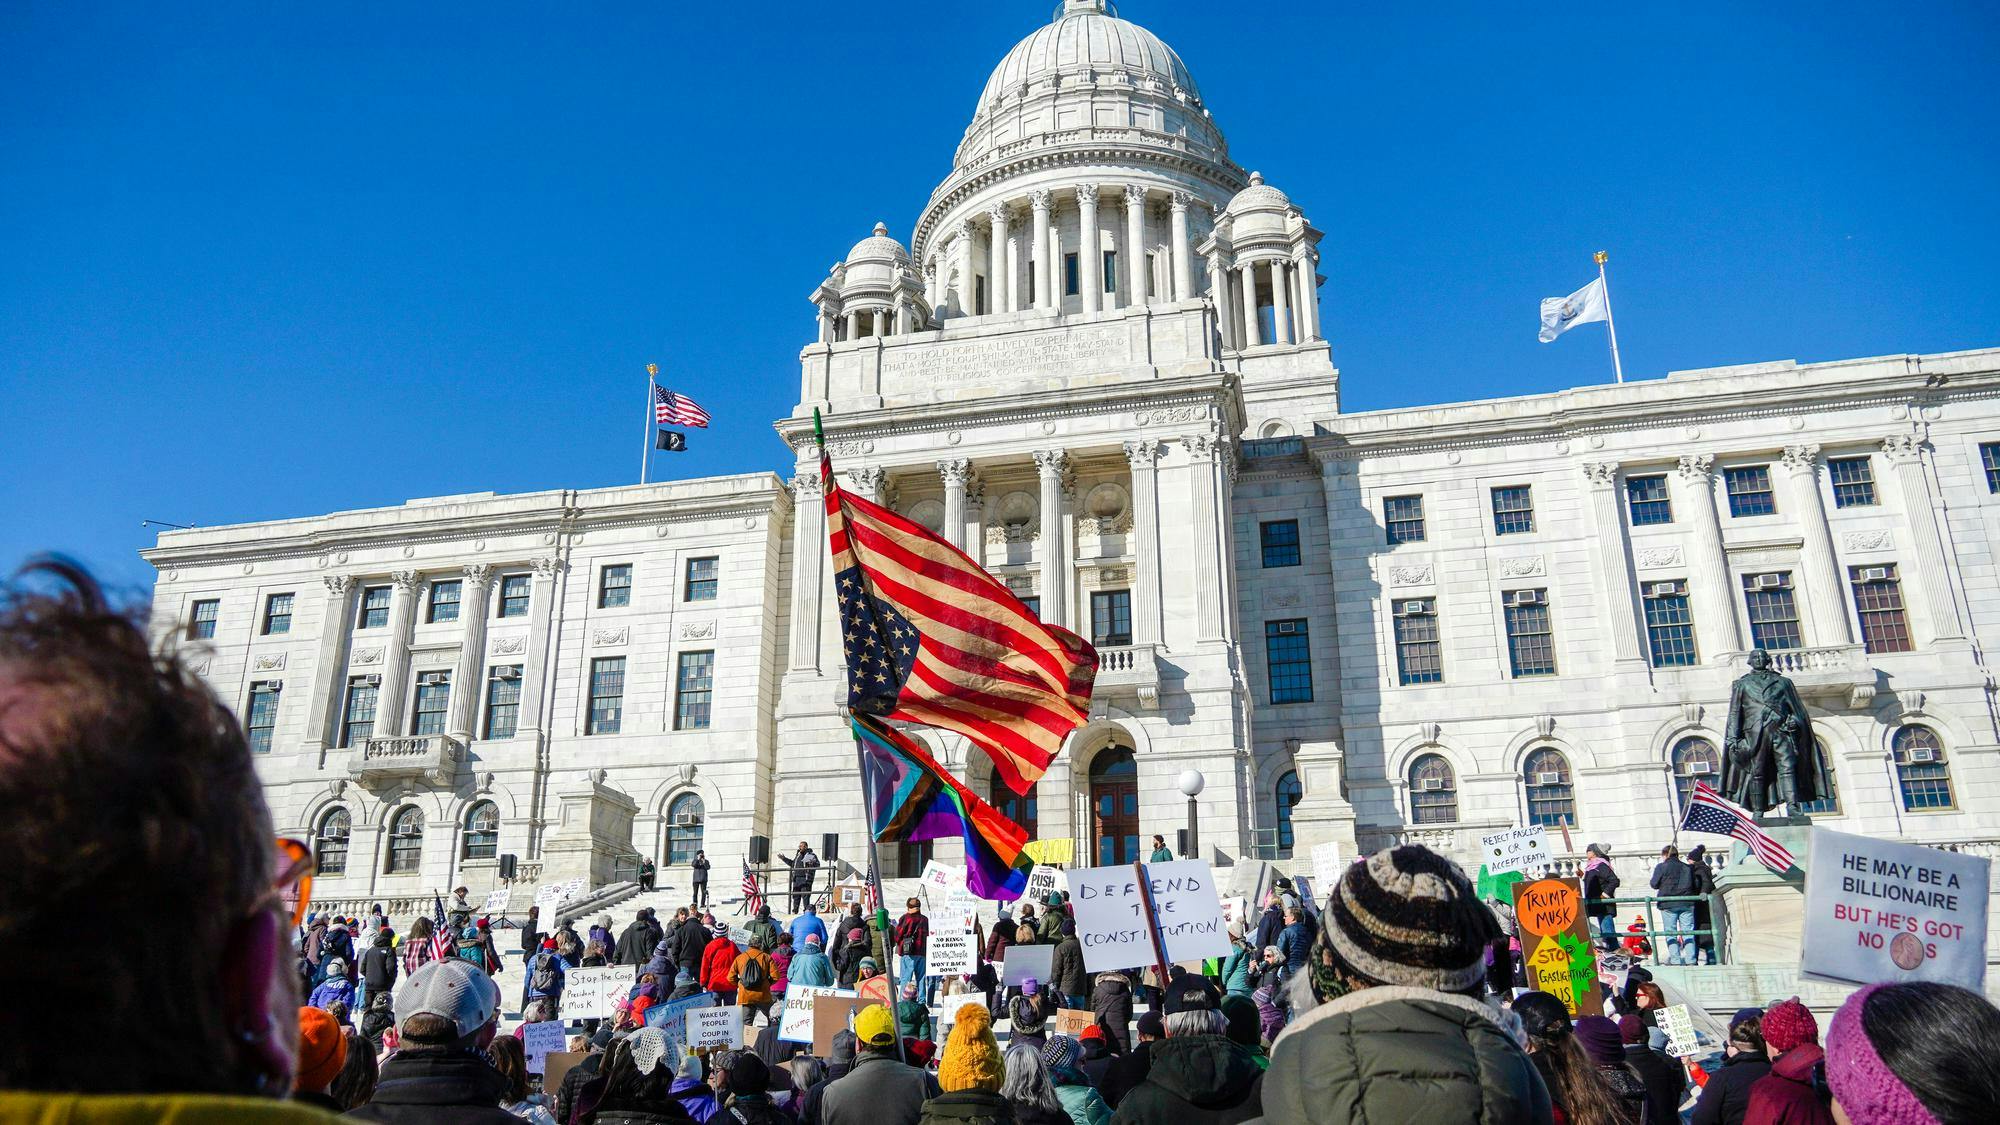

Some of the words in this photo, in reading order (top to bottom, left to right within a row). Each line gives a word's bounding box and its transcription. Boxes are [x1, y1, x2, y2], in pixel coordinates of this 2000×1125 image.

[883, 361, 908, 372] THAT
[1013, 347, 1039, 358] CIVIL
[1042, 344, 1069, 355] STATE
[1073, 341, 1092, 351] MAY
[921, 348, 949, 359] HOLD
[952, 343, 984, 355] FORTH
[996, 340, 1030, 351] LIVELY
[920, 366, 941, 376] BEST
[1482, 833, 1509, 846] REJECT
[1513, 826, 1544, 840] FASCISM
[1508, 842, 1522, 854] OR
[1491, 856, 1520, 872] ACCEPT
[1522, 852, 1546, 865] DEATH
[1842, 853, 1867, 872] HE
[1872, 859, 1912, 880] MAY
[1917, 868, 1942, 885] BE
[1947, 873, 1961, 889] A
[1031, 873, 1055, 889] PUSH
[1080, 876, 1201, 900] DEFEND
[1523, 889, 1568, 912] TRUMP
[1842, 876, 1958, 911] BILLIONAIRE
[1536, 907, 1571, 929] MUSK
[1834, 903, 1872, 924] BUT
[1876, 911, 1919, 933] HE'S
[1924, 920, 1964, 940] GOT
[1083, 917, 1218, 947] CONSTITUTION
[1858, 931, 1884, 949] NO
[1537, 944, 1576, 965] STOP
[571, 971, 598, 986] Stop
[601, 972, 611, 981] the
[1539, 968, 1591, 984] GASLIGHTING
[567, 989, 596, 999] President
[785, 999, 814, 1010] REPUB
[698, 1038, 733, 1046] PROGRESS
[1666, 1045, 1678, 1055] NO
[1679, 1042, 1699, 1053] SHIT
